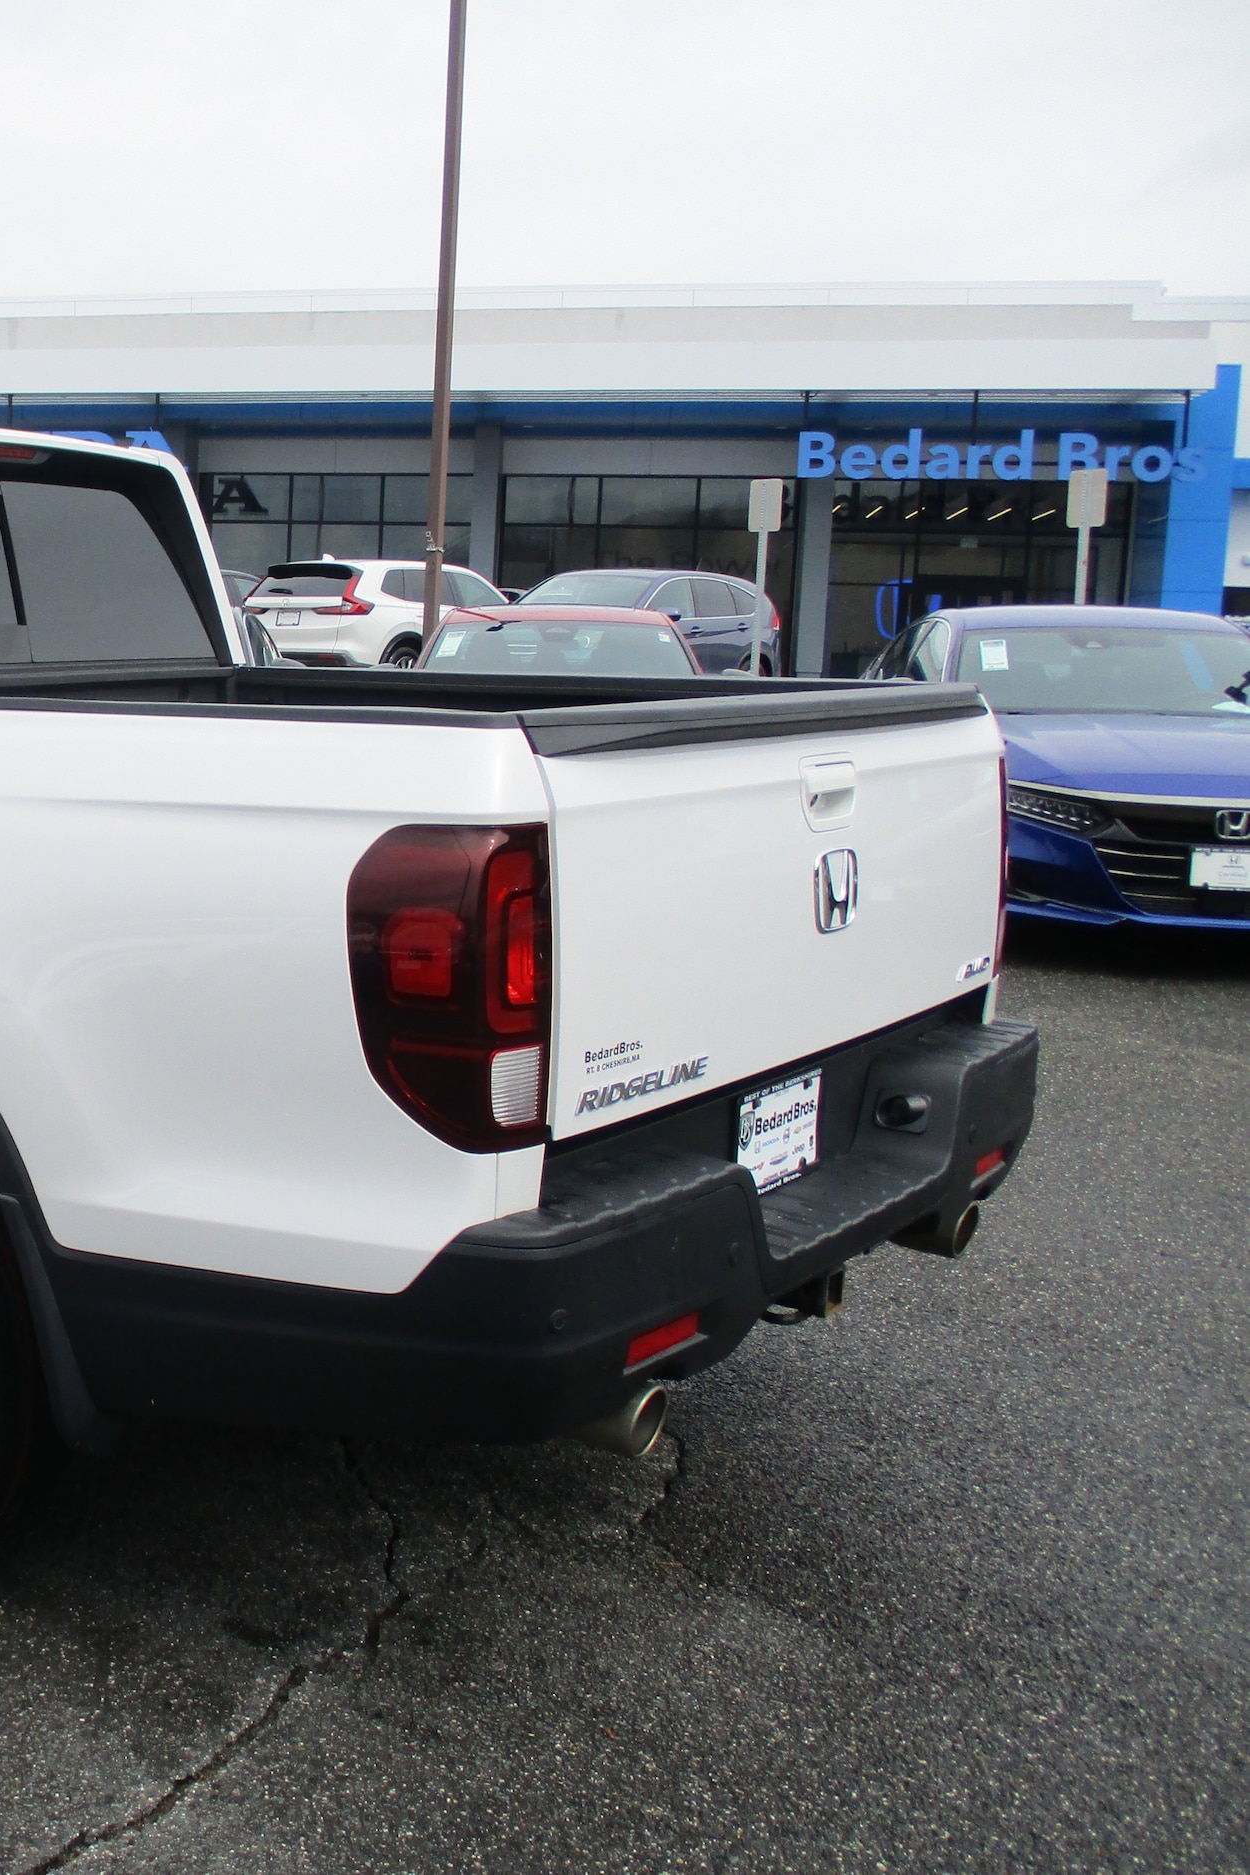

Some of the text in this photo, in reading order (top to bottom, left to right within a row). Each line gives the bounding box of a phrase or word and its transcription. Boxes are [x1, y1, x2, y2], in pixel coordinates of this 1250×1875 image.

[797, 428, 1208, 484] Bedard Bros
[575, 1056, 709, 1116] RIDGELINE
